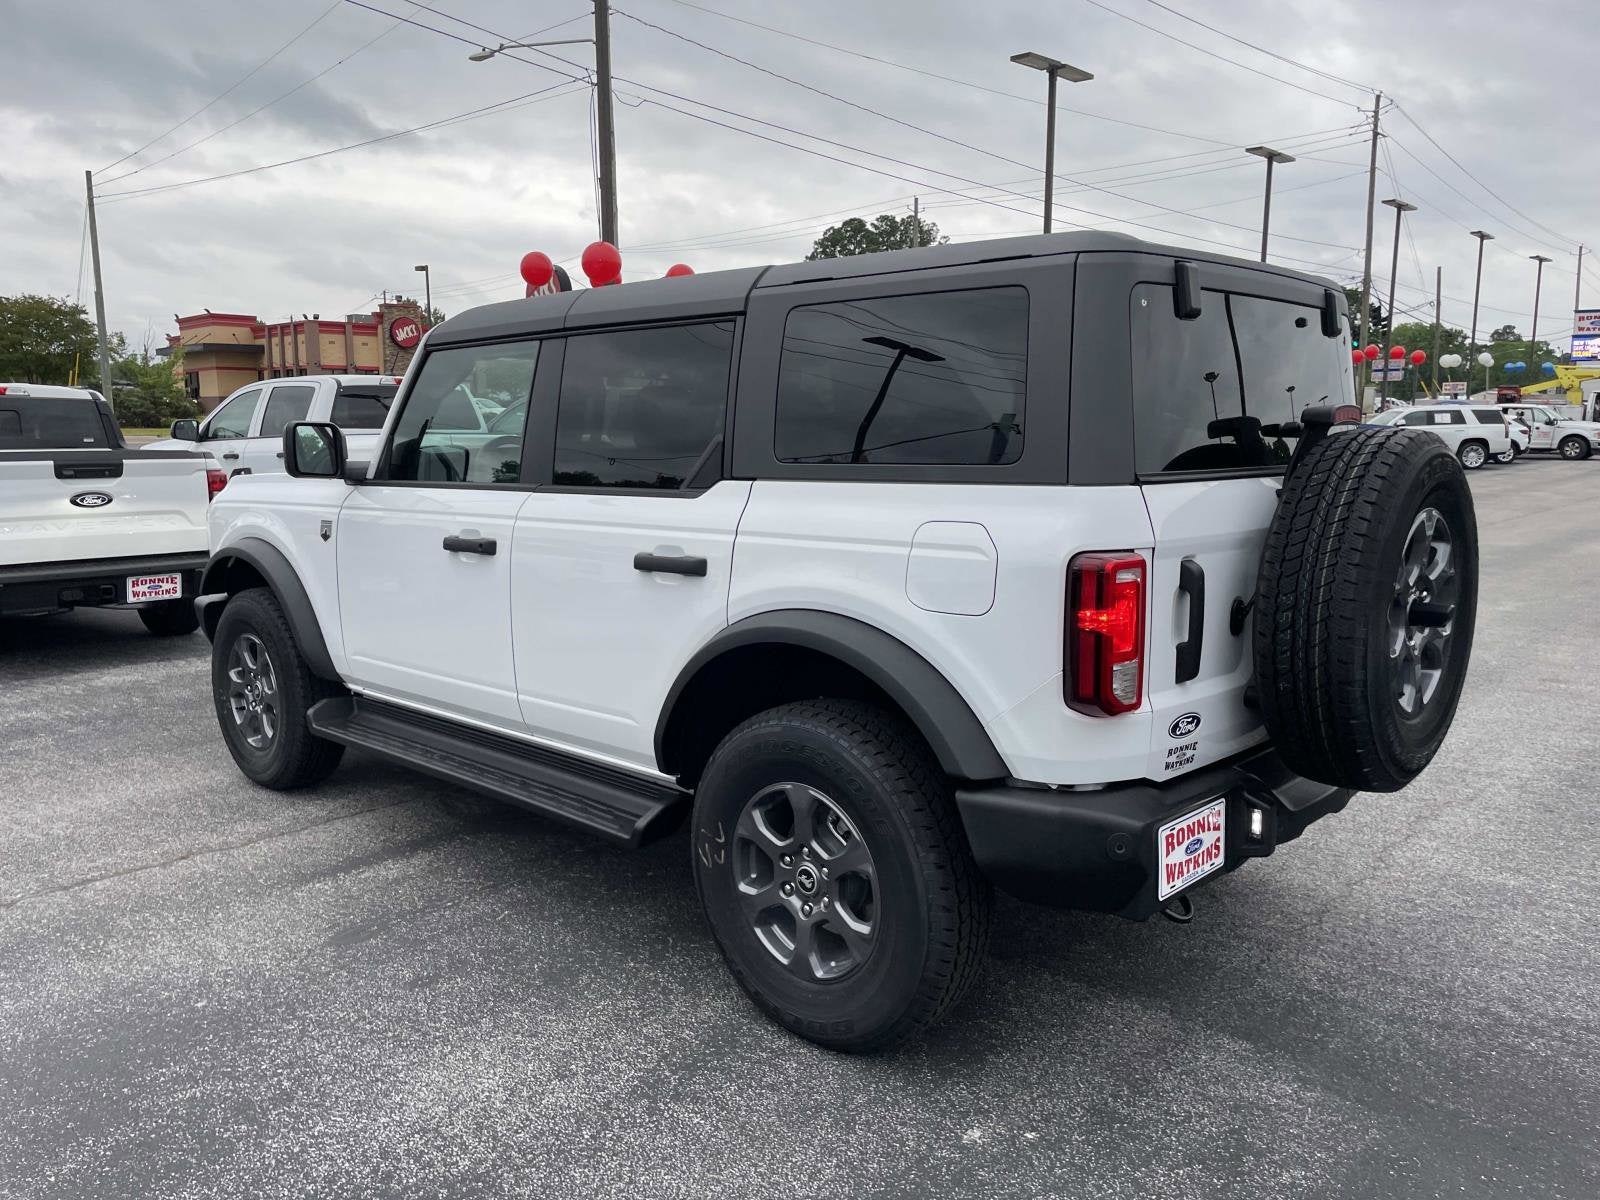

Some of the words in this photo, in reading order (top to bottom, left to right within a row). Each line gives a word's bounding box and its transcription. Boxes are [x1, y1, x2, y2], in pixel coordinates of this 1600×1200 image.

[83, 495, 102, 505] Ford
[131, 577, 178, 588] RONNIE
[131, 587, 178, 598] WATKINS
[1176, 717, 1197, 735] Ford
[1167, 741, 1198, 758] RONNIE
[1164, 753, 1195, 771] WATKINS
[1165, 809, 1221, 858] RONNIE
[1186, 840, 1201, 854] Ford
[1165, 836, 1221, 886] WATKINS
